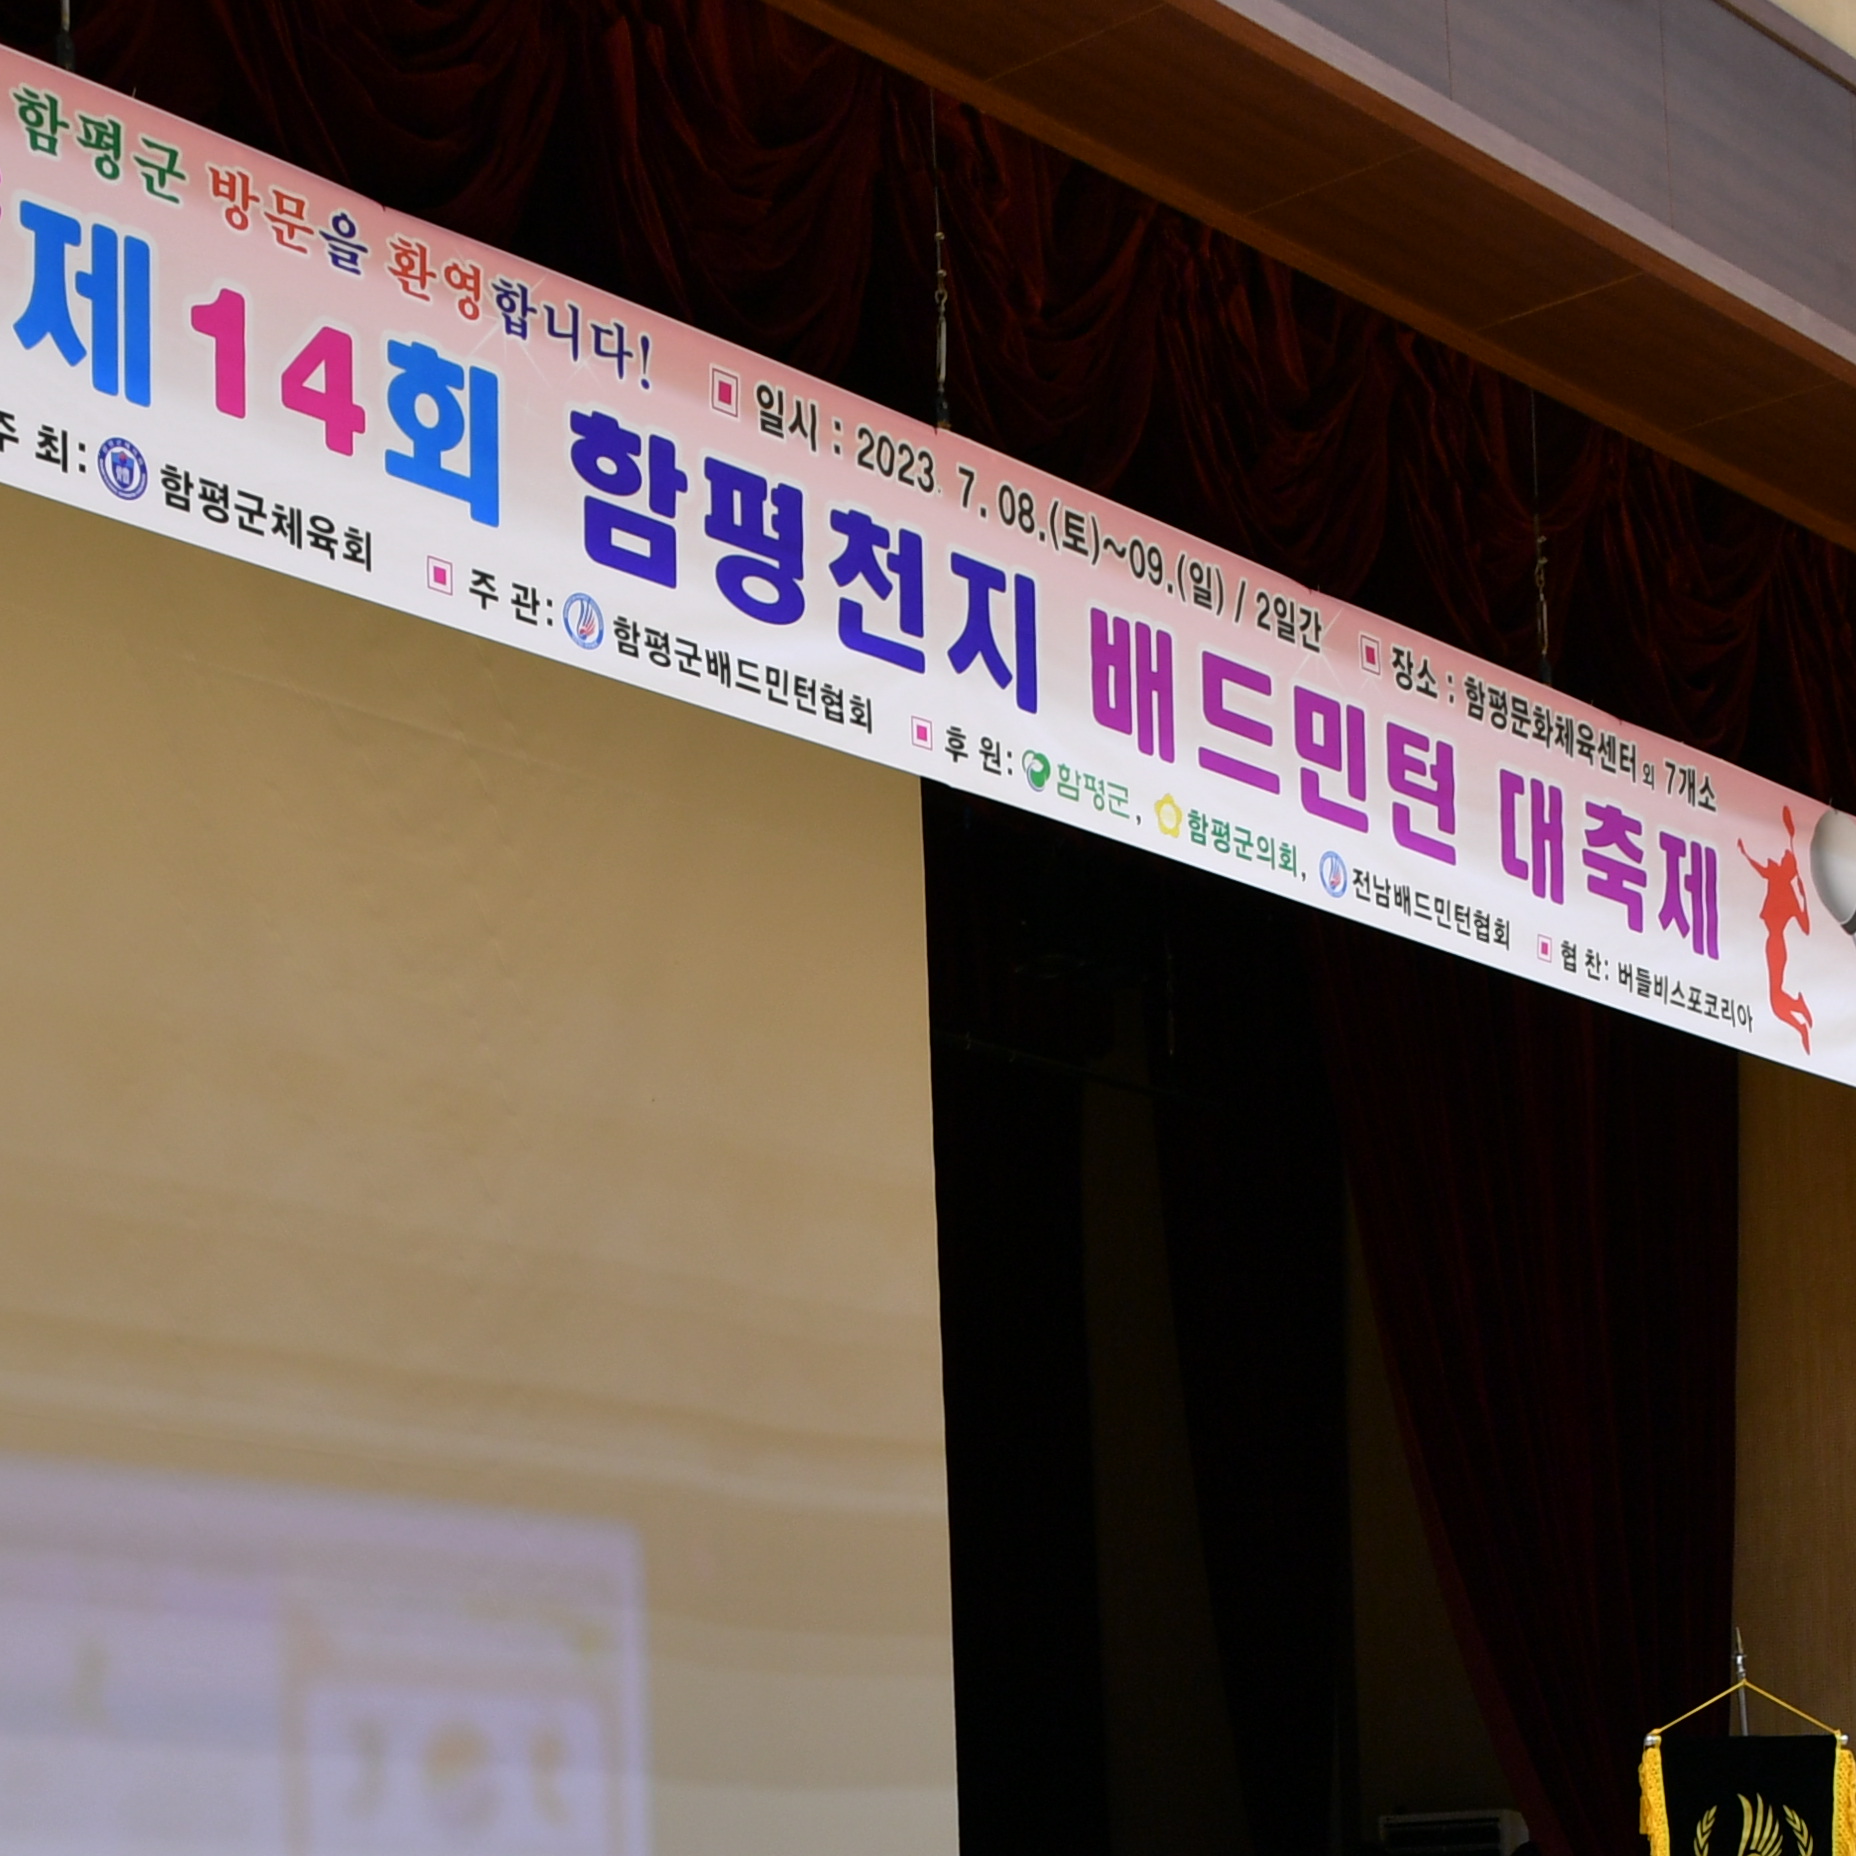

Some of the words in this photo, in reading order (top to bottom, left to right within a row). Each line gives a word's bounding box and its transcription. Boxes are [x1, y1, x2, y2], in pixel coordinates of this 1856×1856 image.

[13, 87, 186, 203] 함평군
[207, 165, 368, 276] 방문을
[387, 235, 652, 390] 환영합니다!
[160, 463, 374, 572] 함평군체육회
[756, 384, 818, 452] 일시
[1256, 588, 1323, 653] 2일간
[569, 410, 1038, 716] 함평천지
[1090, 606, 1457, 866] 배드민턴
[1499, 767, 1720, 962] 대축제
[612, 614, 873, 733] 함평군배드민턴협회
[1390, 645, 1439, 700] 장소
[1464, 673, 1638, 784] 함평문화체육센터
[1664, 759, 1717, 813] 7개소
[1352, 867, 1511, 952] 전남배드민턴협회
[1617, 962, 1755, 1034] 버들비스포코리아
